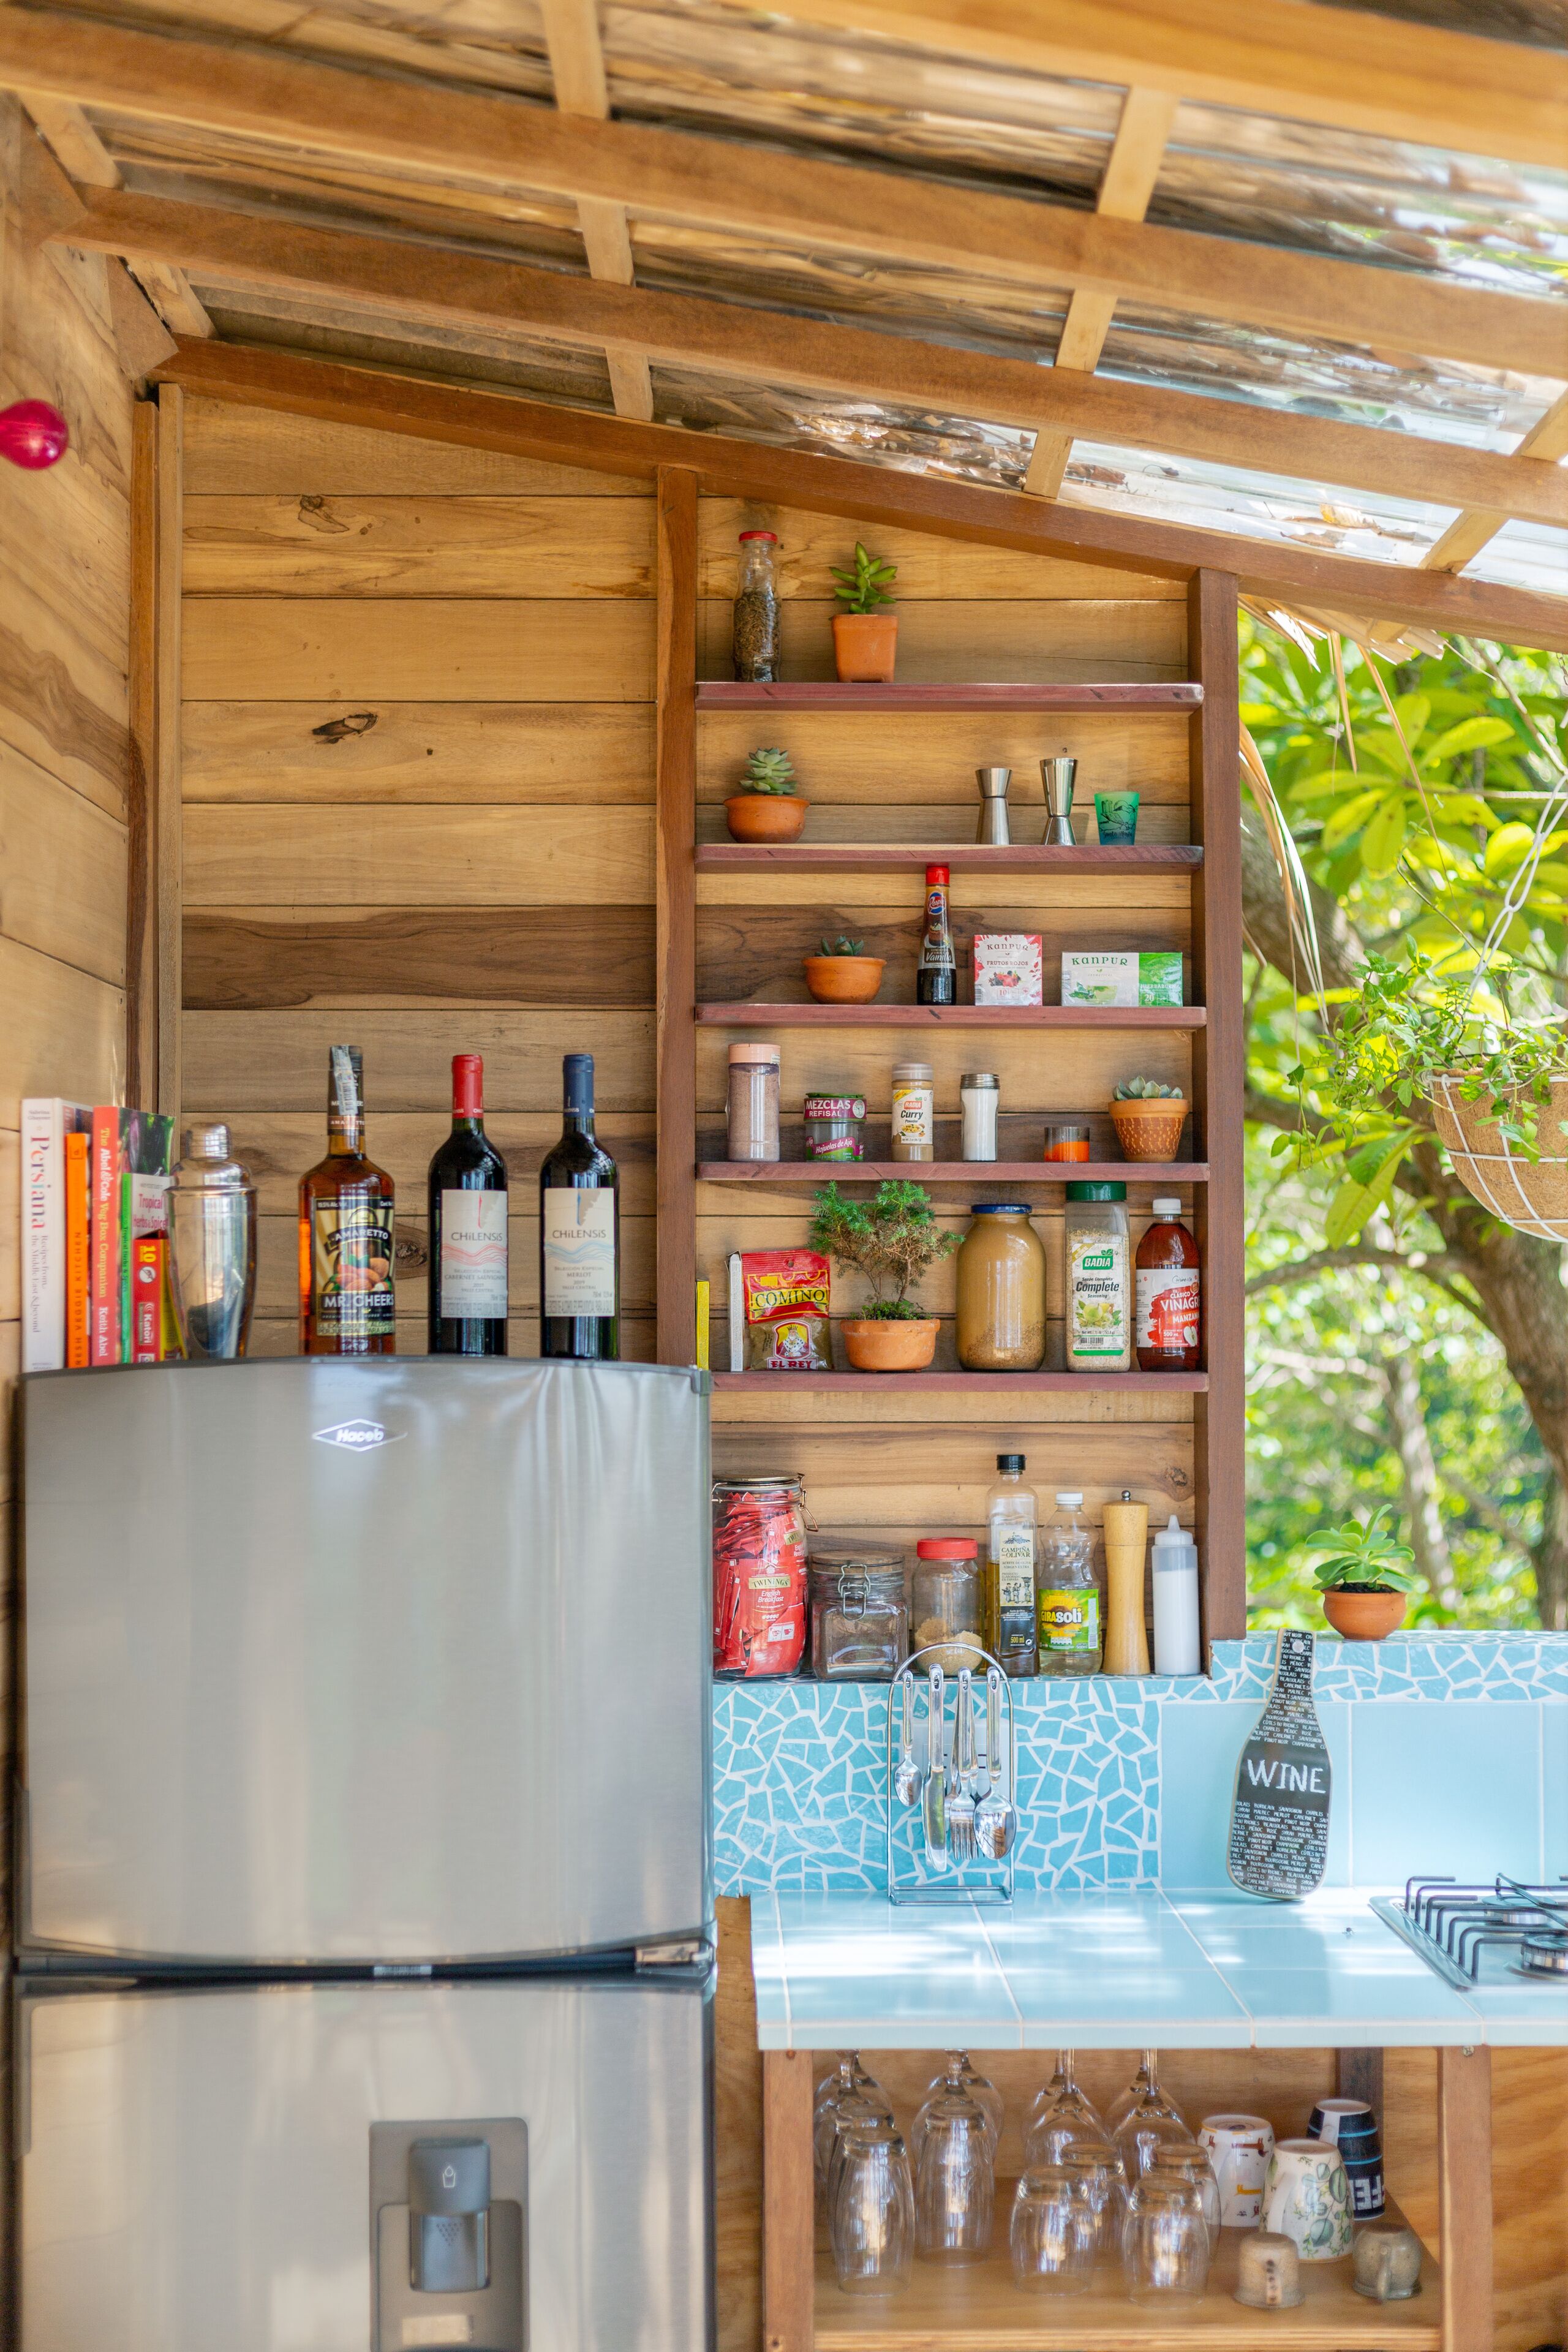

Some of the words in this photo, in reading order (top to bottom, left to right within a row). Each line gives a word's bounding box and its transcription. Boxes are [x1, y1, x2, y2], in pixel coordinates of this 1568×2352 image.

[926, 951, 952, 962] Vainilla
[806, 1100, 851, 1110] MEZCLAS
[901, 1110, 923, 1120] Curry
[100, 1128, 110, 1147] The
[816, 1143, 837, 1153] Hojuelas
[843, 1138, 853, 1147] Ajo
[31, 1137, 51, 1229] Persiana
[139, 1193, 163, 1213] Tropical
[98, 1203, 108, 1221] Veg
[133, 1215, 148, 1228] Herbs
[99, 1222, 108, 1240] Box
[335, 1229, 389, 1241] AMARETTO
[552, 1229, 606, 1239] CHiLENSiS
[143, 1245, 156, 1263] 10
[1084, 1257, 1110, 1267] BADIA
[97, 1243, 108, 1298] Companion
[1076, 1281, 1120, 1294] Complete
[353, 1294, 394, 1307] CHEERS
[755, 1289, 825, 1307] COMINO
[99, 1307, 108, 1333] Keith
[144, 1314, 153, 1343] Katori
[99, 1335, 108, 1357] Abel
[788, 1360, 813, 1369] REY
[336, 1428, 384, 1442] Haceb
[752, 1578, 789, 1588] TWININGS
[761, 1590, 781, 1599] English
[1247, 1758, 1326, 1794] WINE
